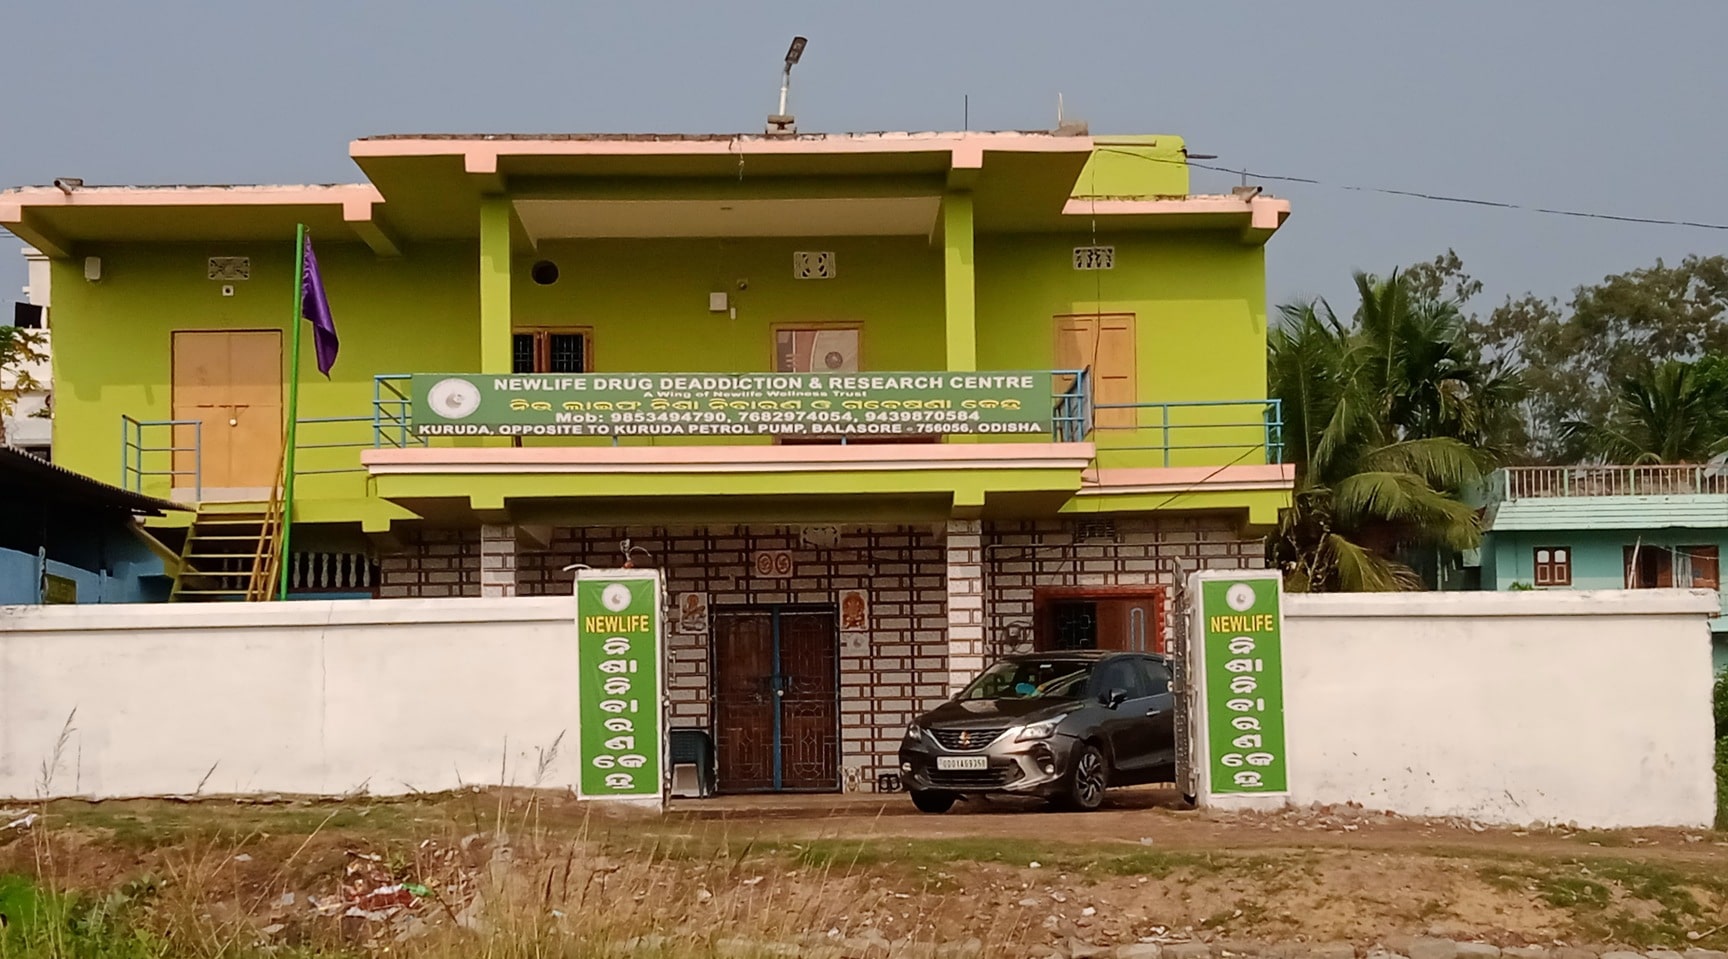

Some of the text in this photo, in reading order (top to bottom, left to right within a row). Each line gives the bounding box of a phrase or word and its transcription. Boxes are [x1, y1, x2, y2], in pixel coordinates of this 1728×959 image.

[494, 376, 1034, 390] NEWLIFE DRUG DEADDICTION & RESEARCH CENTRE
[657, 391, 691, 399] Wing
[555, 412, 604, 422] Mob:
[738, 411, 858, 423] 7682974054,
[865, 411, 980, 422] 9439870584
[419, 425, 494, 436] KURUDA,
[499, 425, 583, 435] OPPOSITE
[588, 425, 609, 434] TO
[614, 424, 684, 434] KURUDA
[689, 424, 754, 434] PETROL
[758, 424, 807, 434] PUMP,
[812, 423, 902, 433] BALASORE
[917, 423, 973, 433] 756056,
[978, 423, 1041, 432] ODISHA
[585, 615, 650, 633] NEWLIFE
[1210, 614, 1274, 633] NEWLIFE
